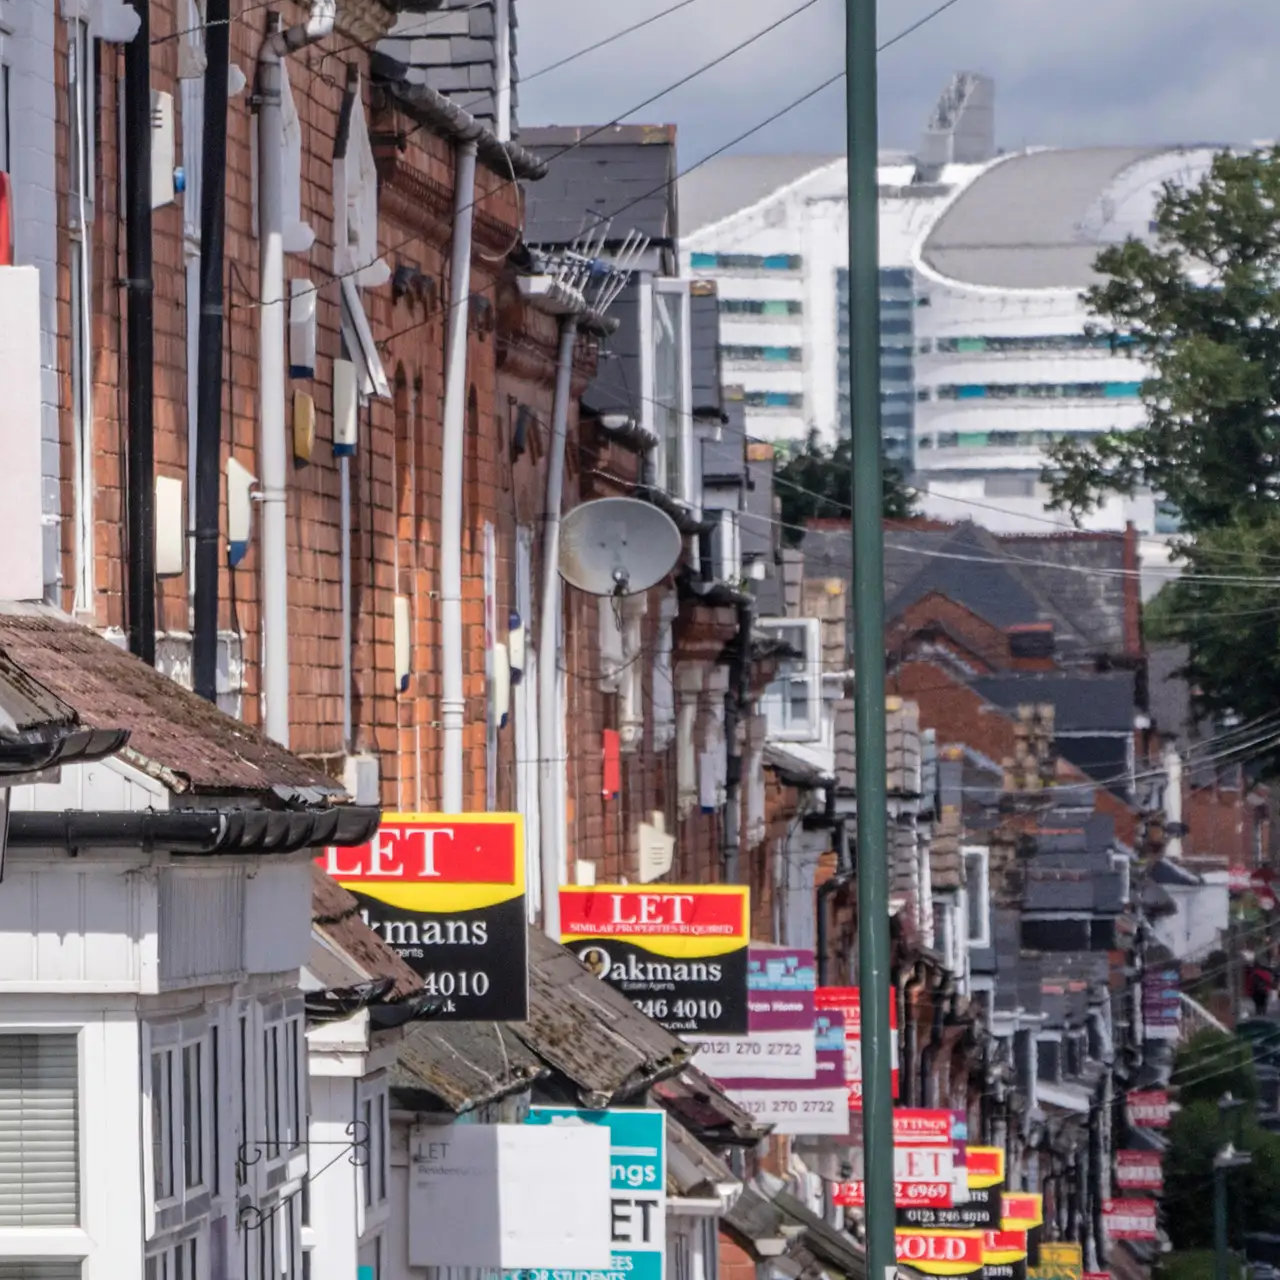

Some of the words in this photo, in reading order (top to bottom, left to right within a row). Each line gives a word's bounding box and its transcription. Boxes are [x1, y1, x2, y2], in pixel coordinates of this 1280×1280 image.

[324, 828, 454, 876] LET
[610, 894, 694, 924] LET
[569, 922, 614, 932] SIMILAR
[391, 948, 424, 959] gents
[424, 971, 490, 997] 4010
[673, 999, 722, 1019] 4010
[736, 1042, 761, 1055] 270
[768, 1043, 801, 1056] 2722
[771, 1101, 797, 1113] 270
[803, 1100, 834, 1113] 2722
[896, 1152, 947, 1177] ET
[907, 1183, 948, 1198] 6969
